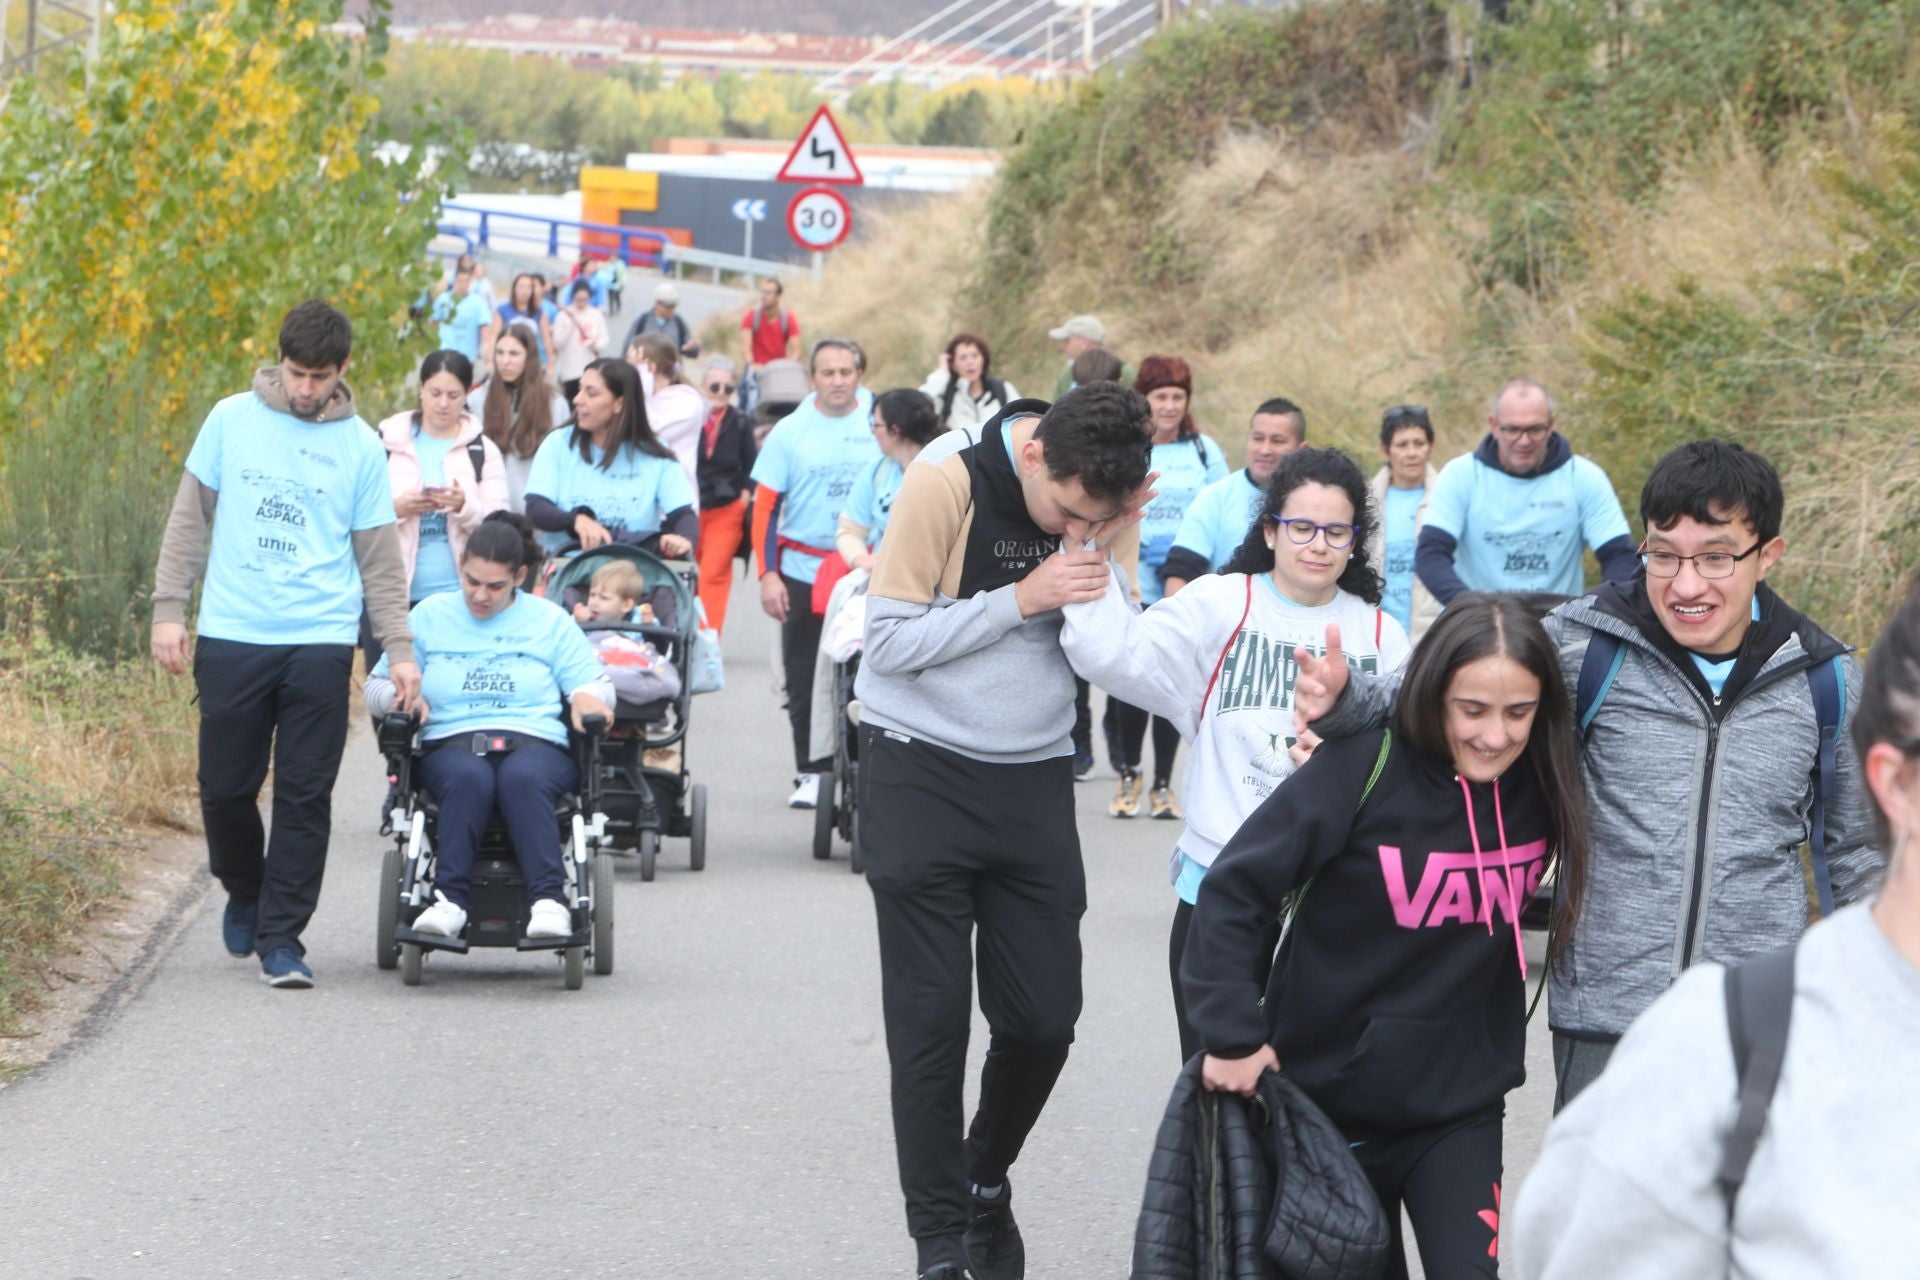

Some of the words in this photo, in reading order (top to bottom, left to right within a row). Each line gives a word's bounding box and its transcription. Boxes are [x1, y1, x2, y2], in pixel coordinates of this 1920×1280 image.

[801, 208, 837, 228] 30
[256, 506, 307, 527] ASPACE
[1001, 561, 1026, 569] NEW
[466, 671, 511, 681] Marcha
[462, 681, 516, 692] ASPACE
